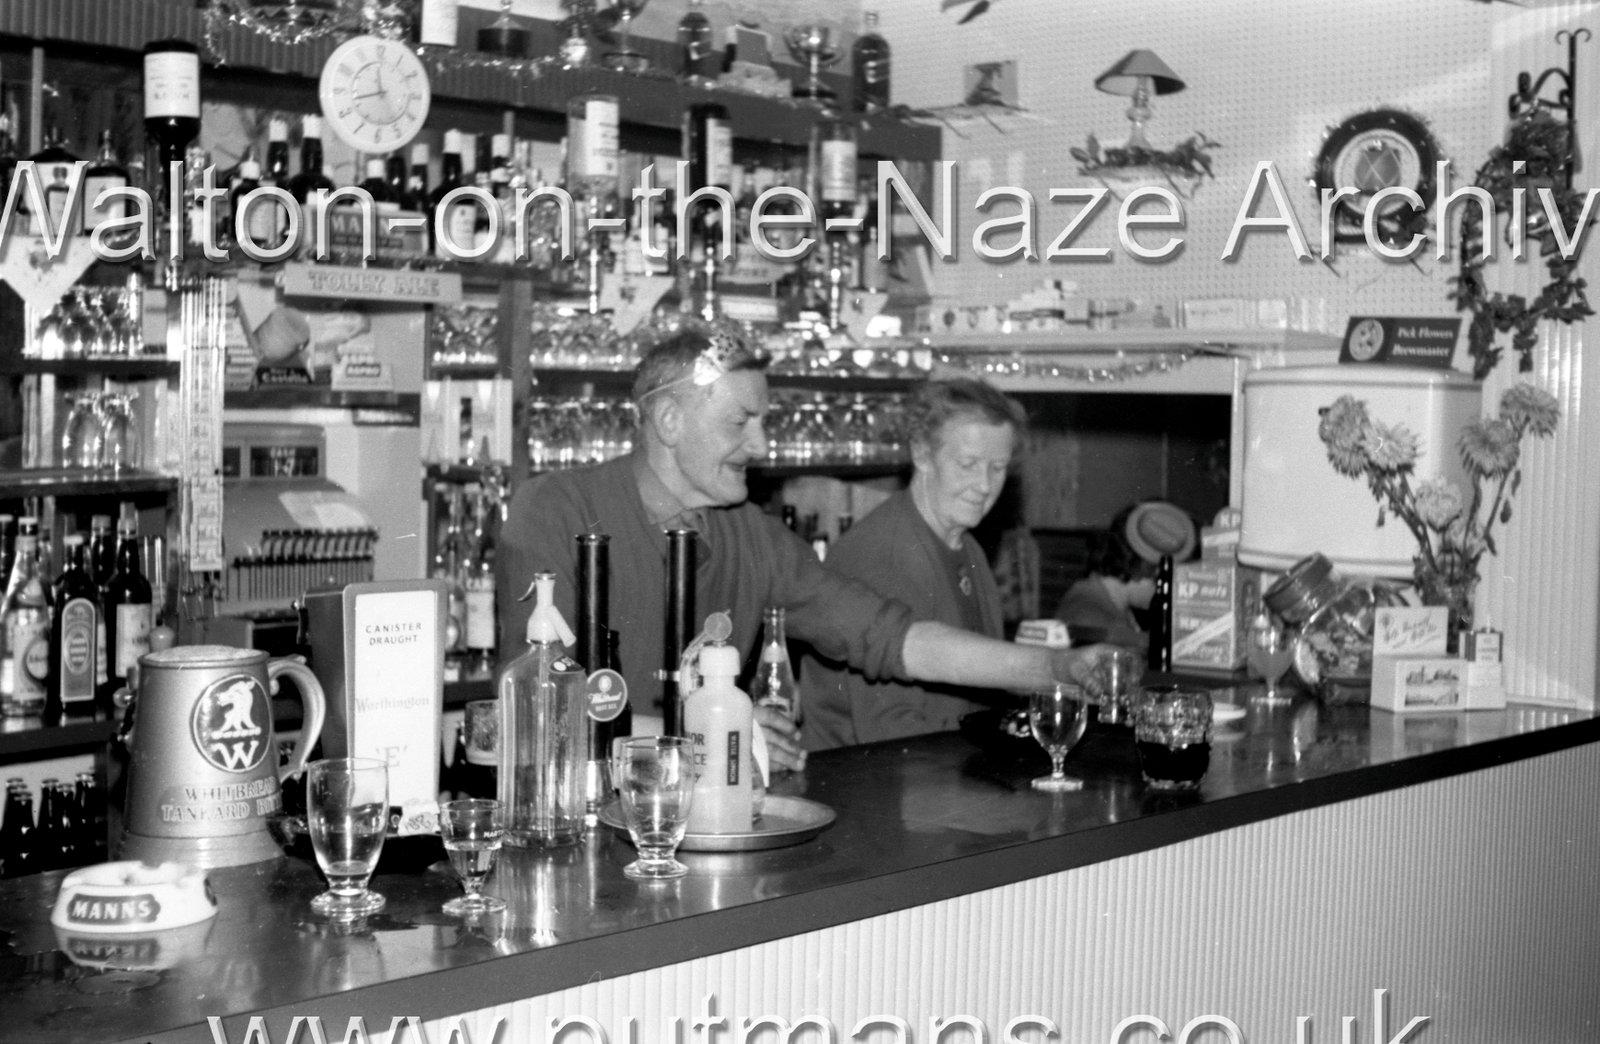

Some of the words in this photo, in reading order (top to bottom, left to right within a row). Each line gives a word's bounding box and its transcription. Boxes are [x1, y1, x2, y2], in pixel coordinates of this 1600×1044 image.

[1178, 581, 1199, 598] KP
[365, 621, 422, 634] CANISTER
[369, 634, 418, 646] DRAUGHT
[355, 696, 431, 714] Worthington
[210, 740, 260, 770] W
[161, 801, 251, 823] TANKARD
[71, 899, 152, 920] MANNS
